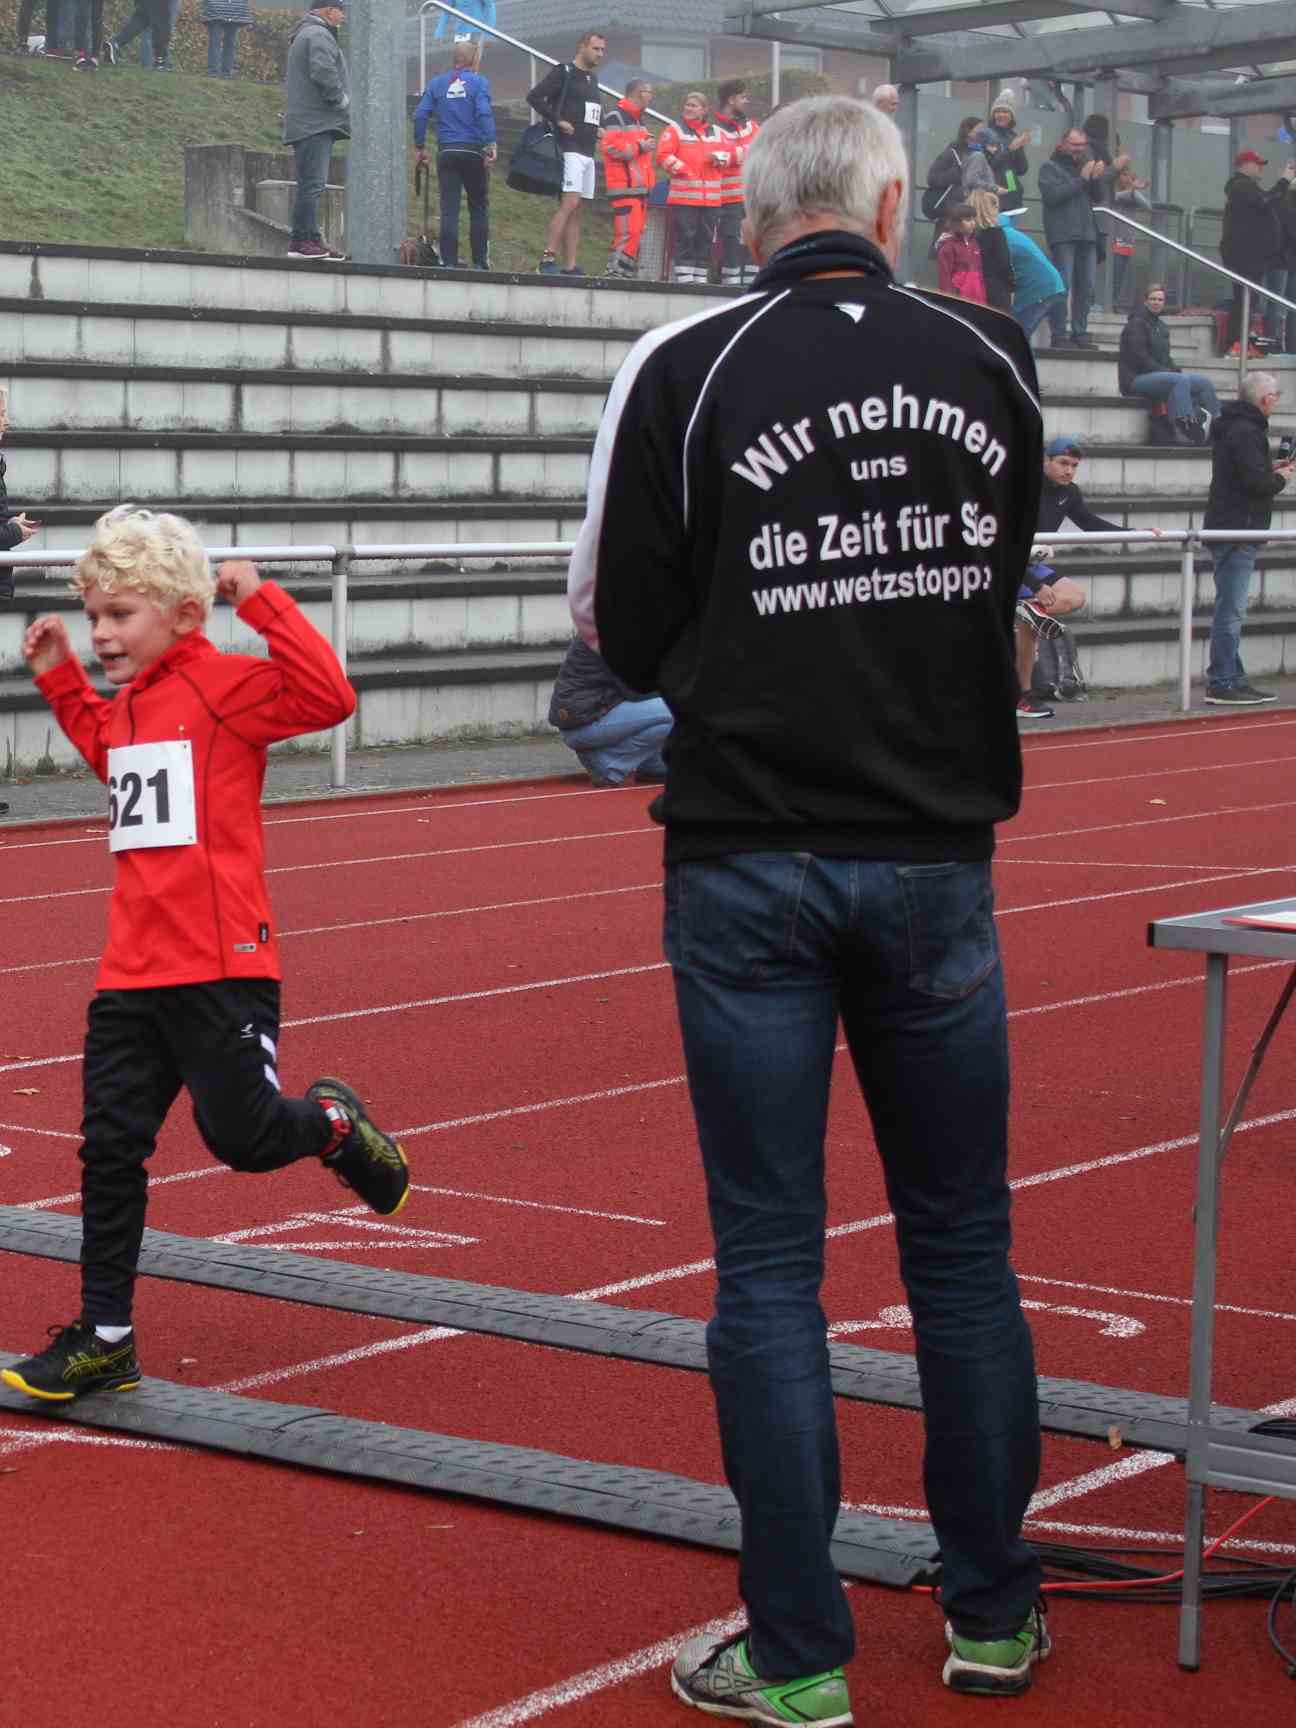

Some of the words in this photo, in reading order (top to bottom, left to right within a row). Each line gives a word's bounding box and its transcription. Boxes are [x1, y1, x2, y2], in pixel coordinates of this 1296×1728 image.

[730, 417, 815, 491] Wir
[827, 384, 1007, 476] nehmen
[850, 455, 908, 480] uns
[749, 523, 808, 570] die
[817, 512, 888, 560] Zeit
[897, 504, 950, 551] für
